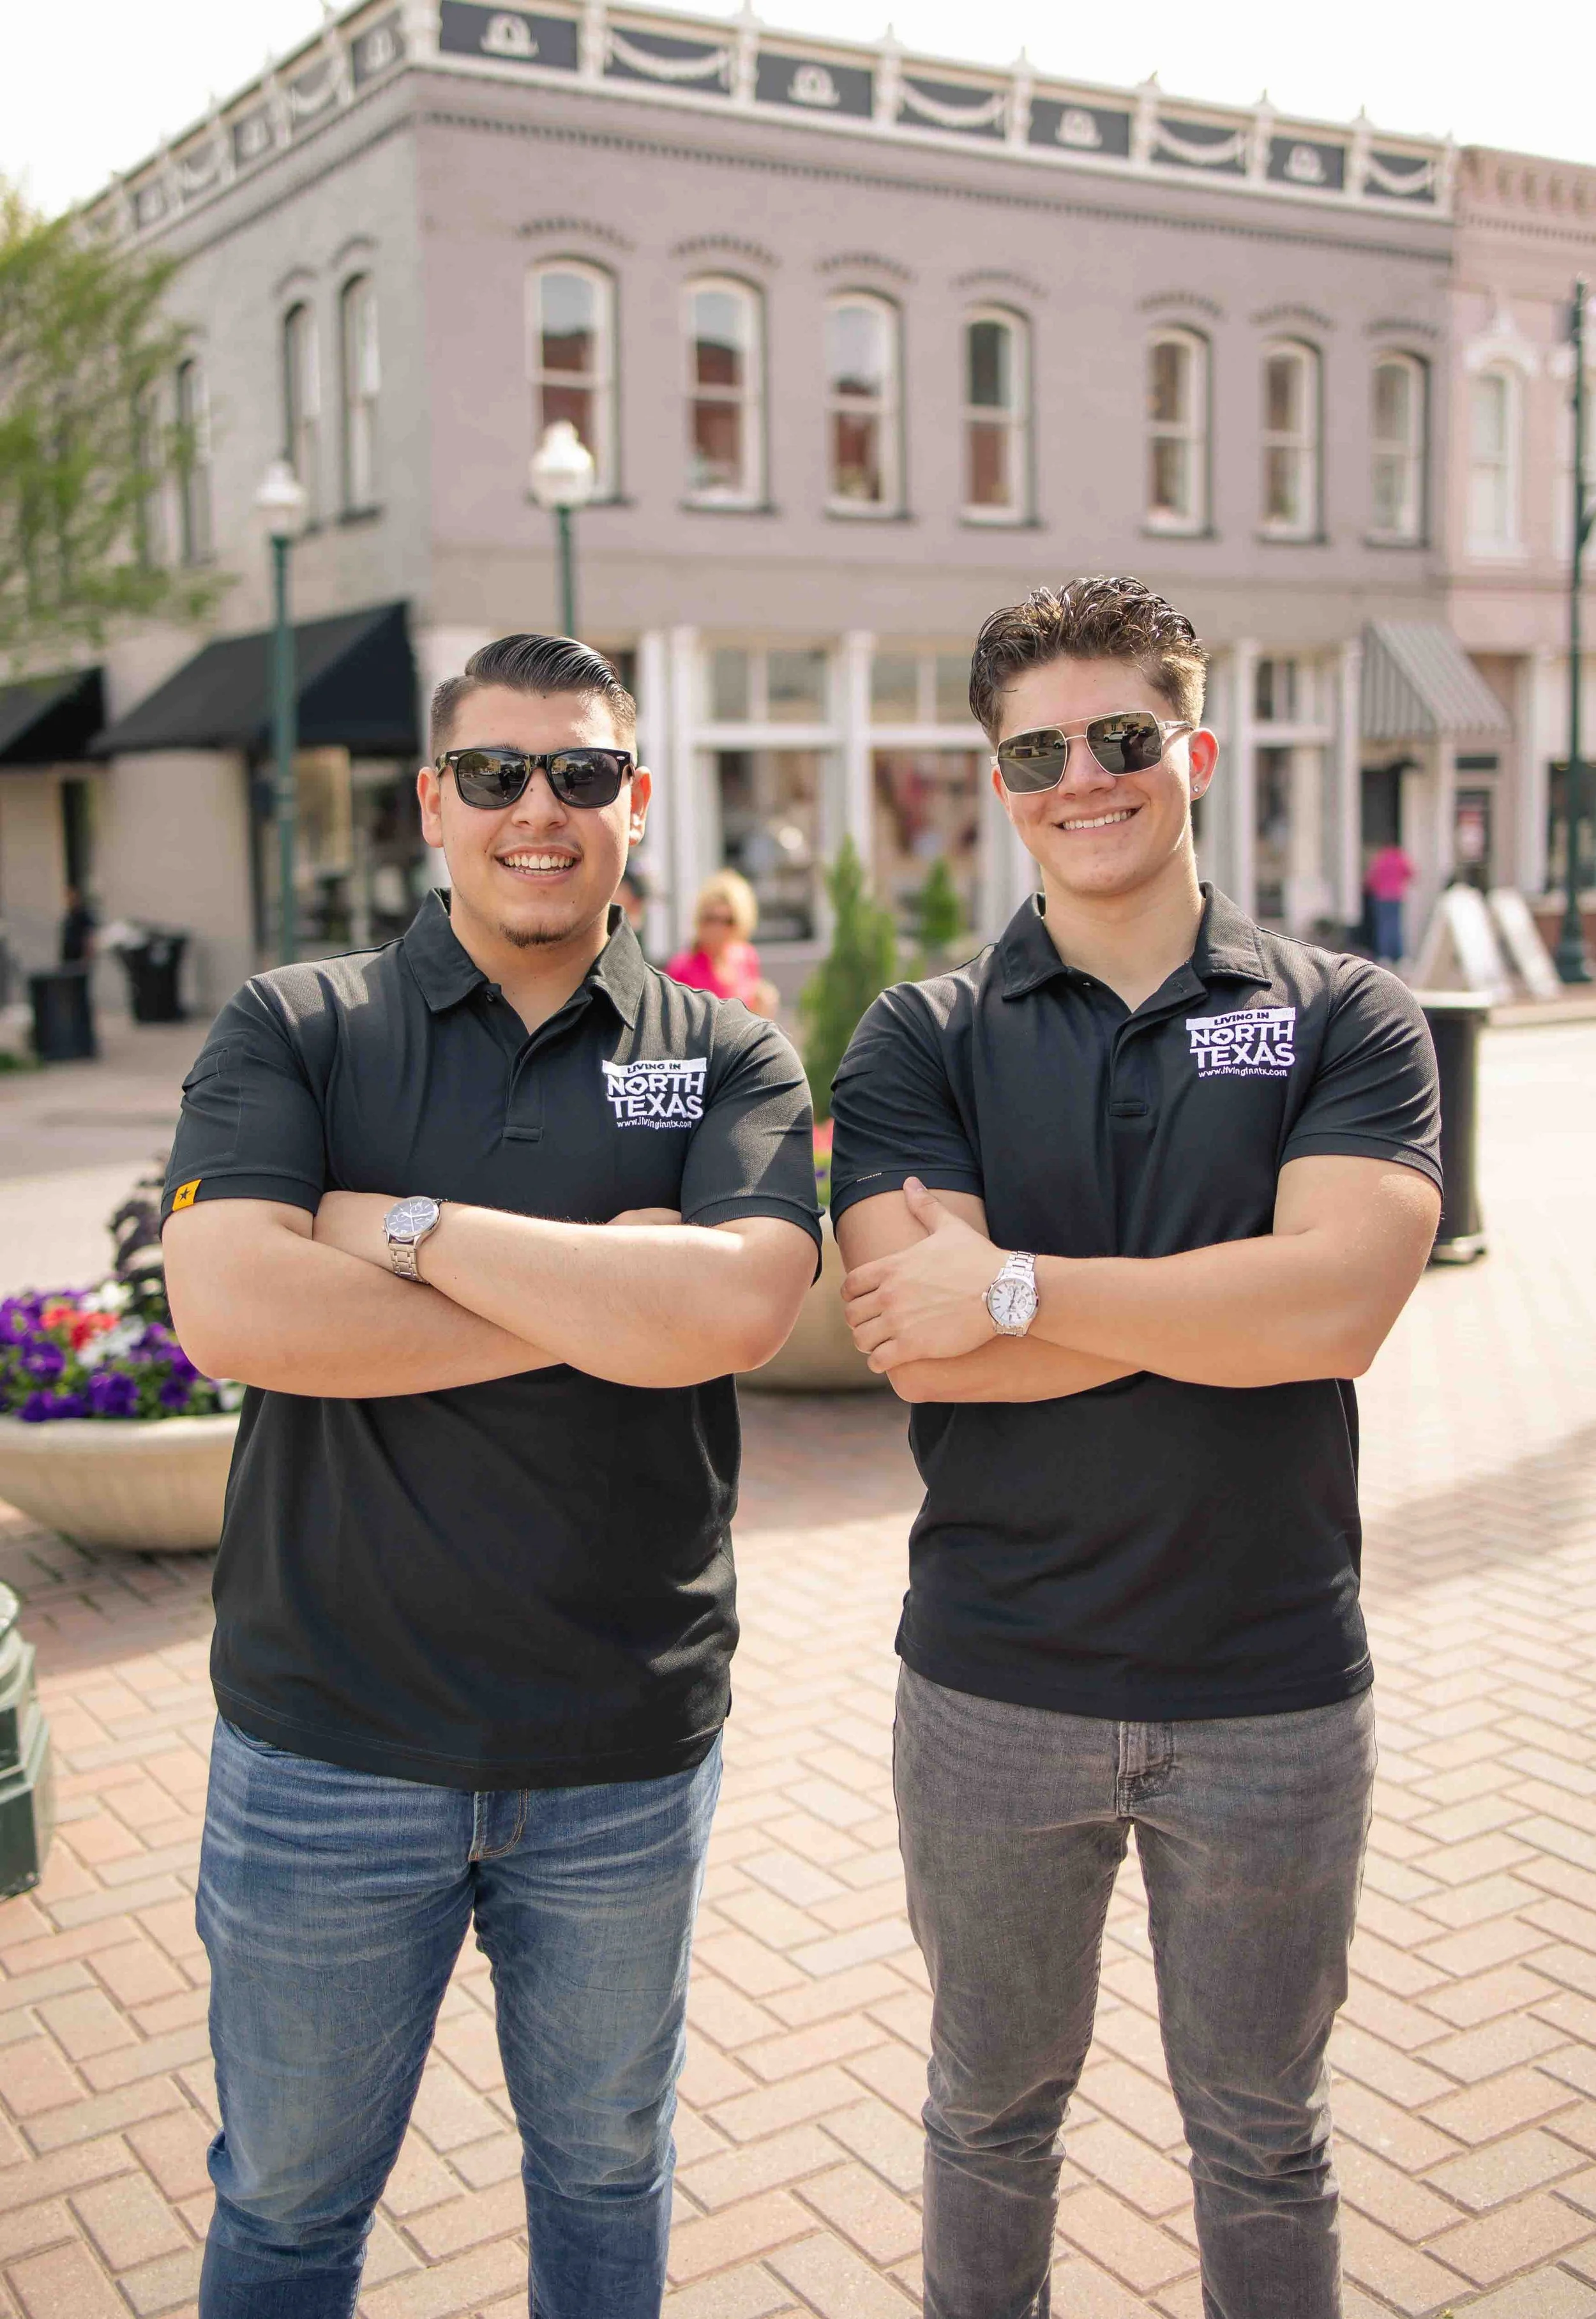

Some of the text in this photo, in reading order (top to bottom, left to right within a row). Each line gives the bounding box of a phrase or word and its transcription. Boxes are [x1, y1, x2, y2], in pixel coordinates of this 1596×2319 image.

[1214, 1013, 1253, 1025] LIVING
[1191, 1021, 1295, 1047] NORTH
[1189, 1041, 1295, 1069] TEXAS
[627, 1063, 665, 1074] LIVING
[607, 1072, 705, 1096] NORTH
[607, 1092, 704, 1120] TEXAS
